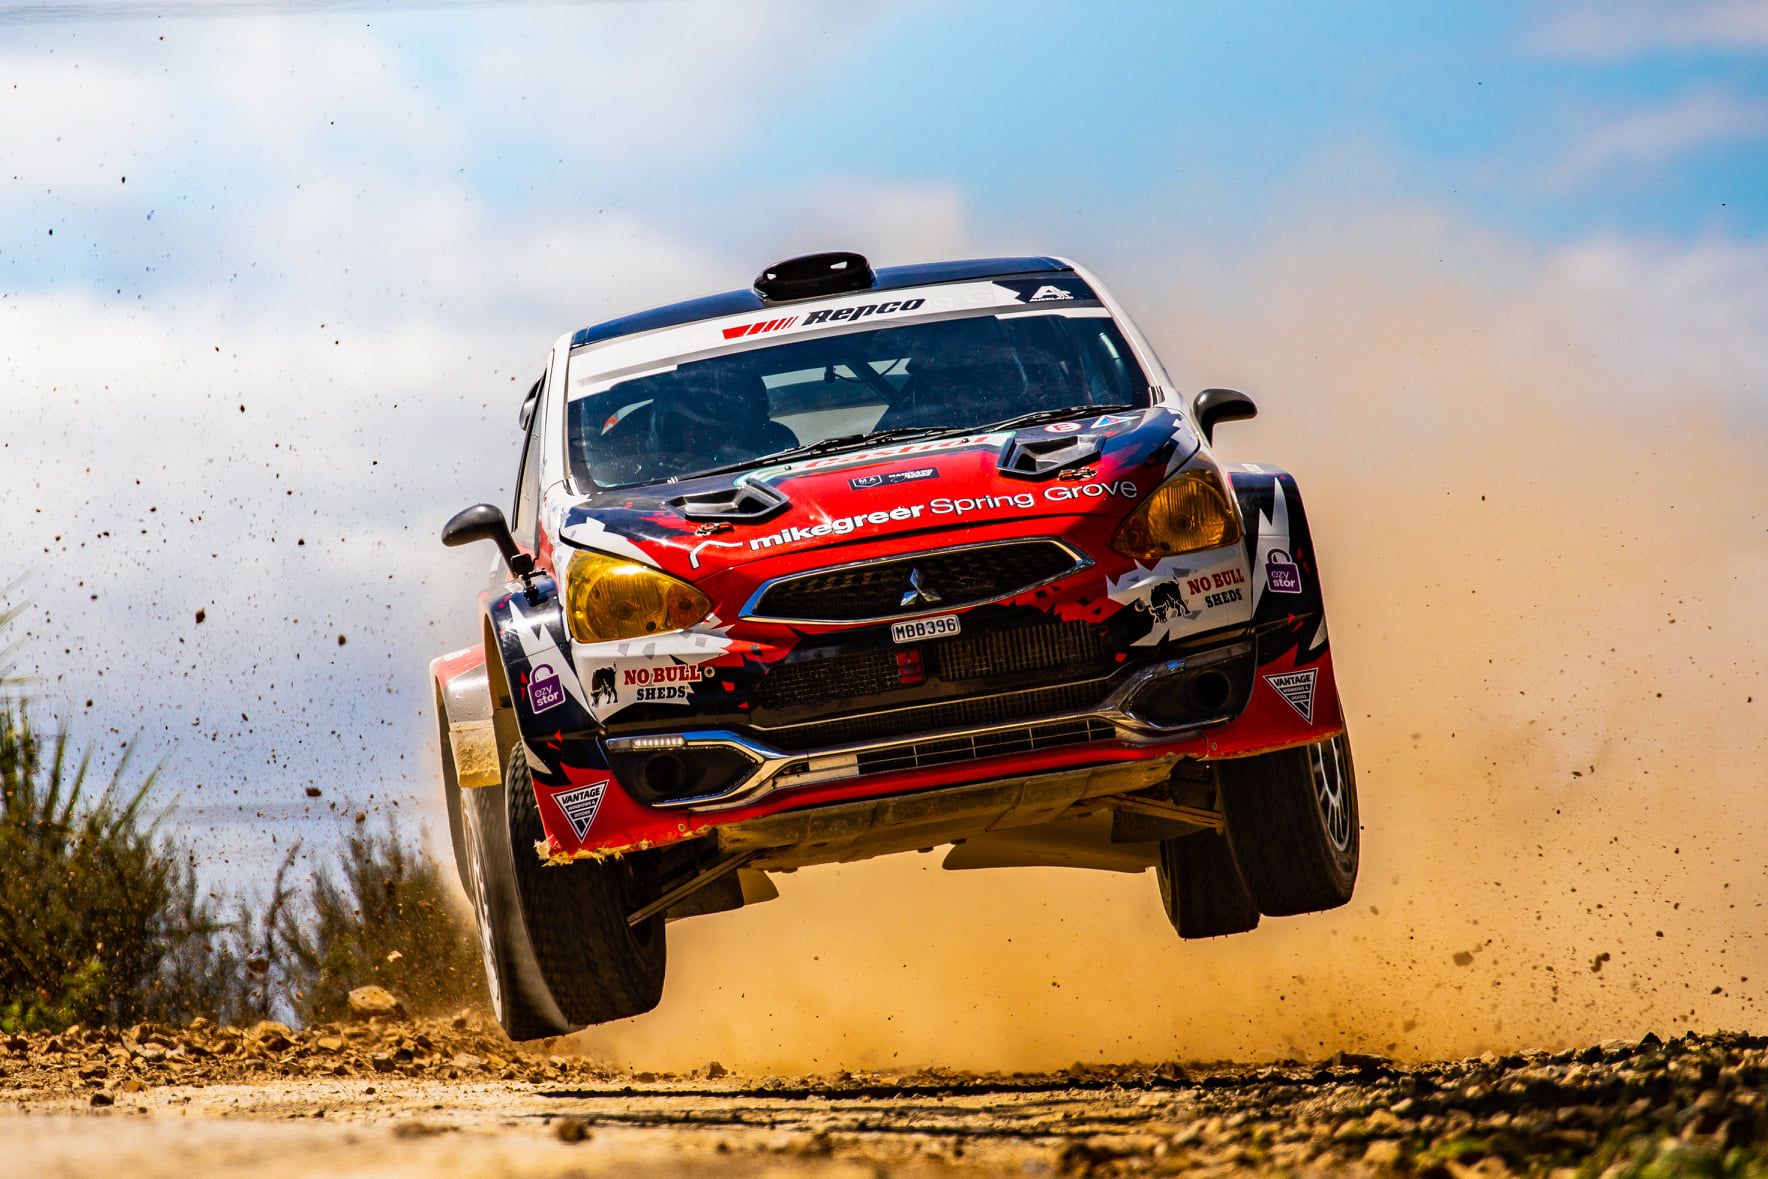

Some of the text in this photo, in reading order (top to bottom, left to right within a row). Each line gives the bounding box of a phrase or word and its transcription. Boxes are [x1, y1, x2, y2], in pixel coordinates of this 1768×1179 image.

[801, 298, 926, 327] Repco
[750, 479, 1138, 551] mikegreer Spring Grove
[1187, 568, 1244, 595] NO BULL
[1271, 570, 1290, 582] ezy
[1273, 578, 1296, 588] stor
[1205, 589, 1242, 608] SHEDS
[896, 618, 956, 640] MBB396
[624, 665, 701, 686] NO BULL
[1274, 674, 1311, 686] VANTAGE
[534, 683, 553, 698] ezy
[537, 691, 559, 707] stor
[636, 686, 688, 701] SHEDS
[561, 787, 601, 804] VANTAGE
